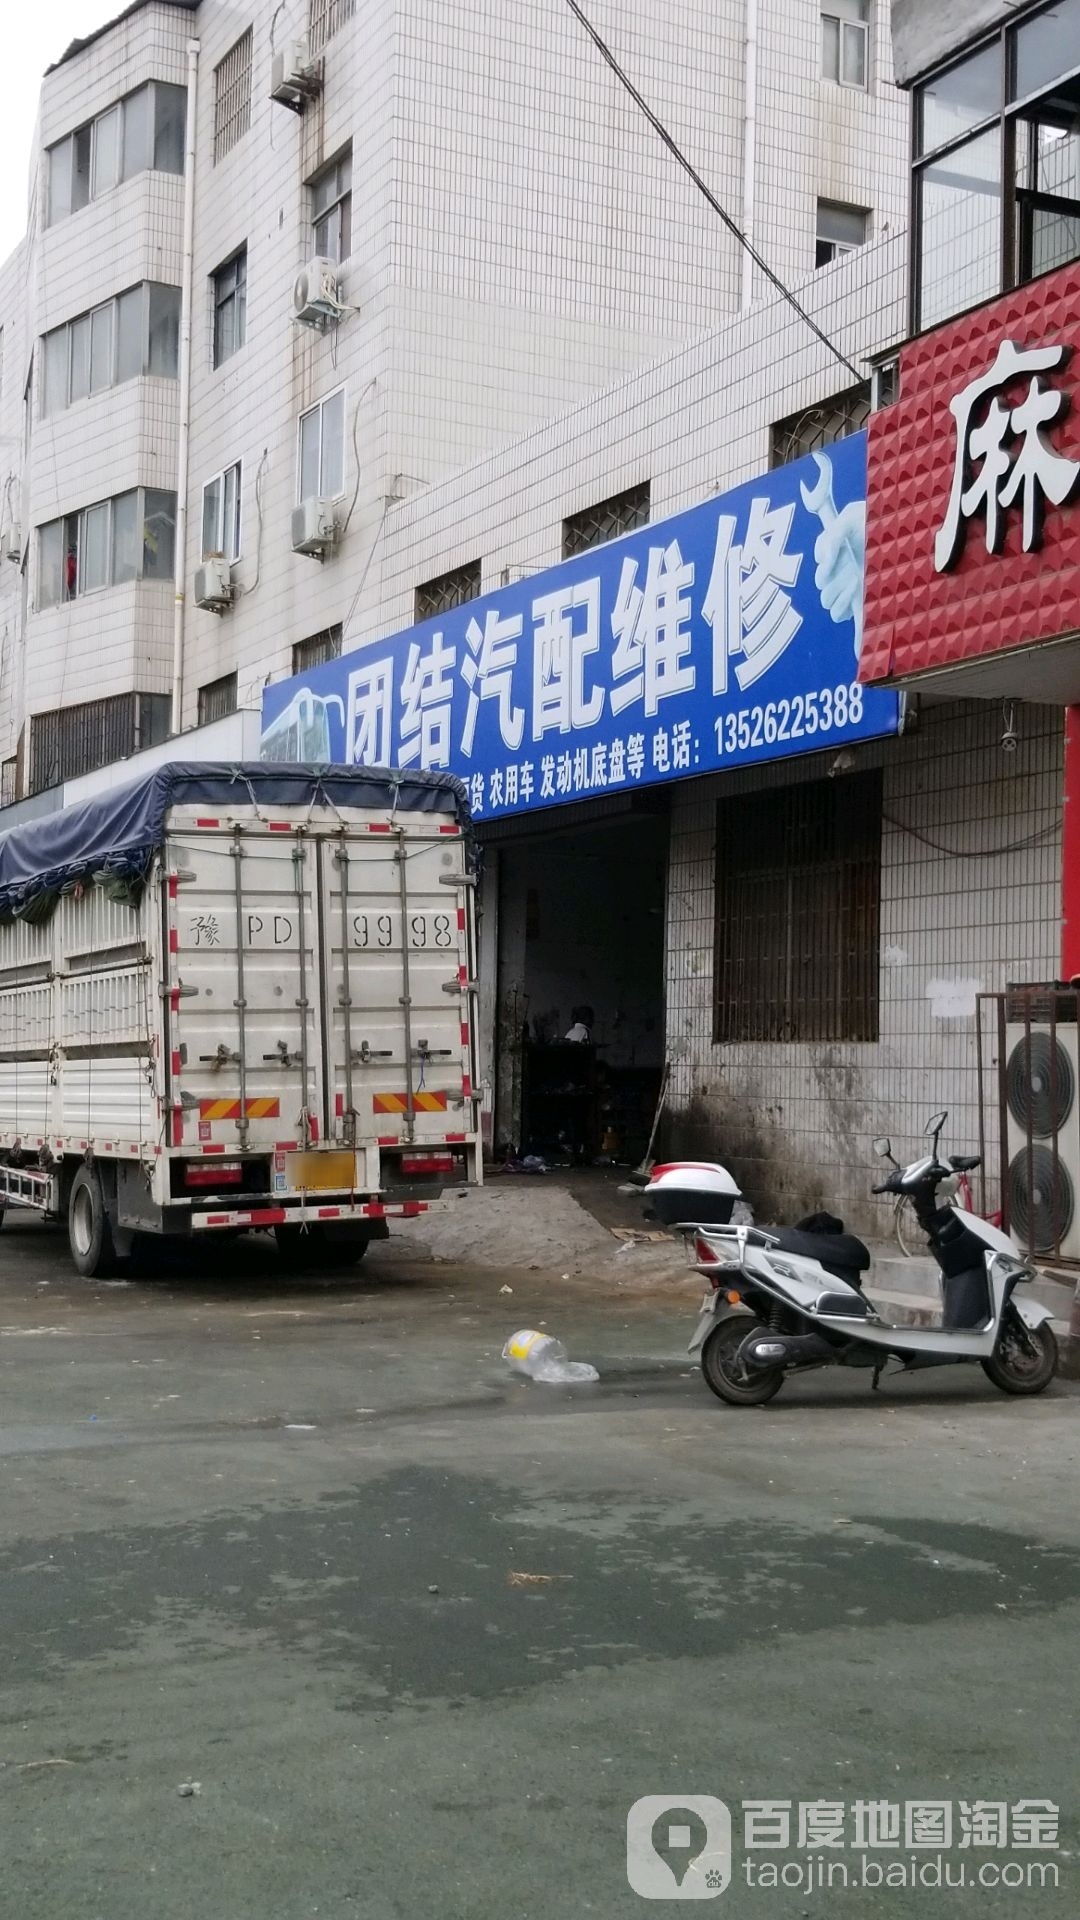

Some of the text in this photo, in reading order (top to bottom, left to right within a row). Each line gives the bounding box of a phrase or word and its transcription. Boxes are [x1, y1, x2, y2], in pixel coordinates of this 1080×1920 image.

[934, 339, 1080, 573] 麻
[346, 496, 803, 769] 团结汽配维修
[489, 760, 535, 809] 农用车
[540, 732, 645, 799] 发动机底盘等
[714, 680, 864, 756] 13526225388
[353, 914, 452, 947] 9998
